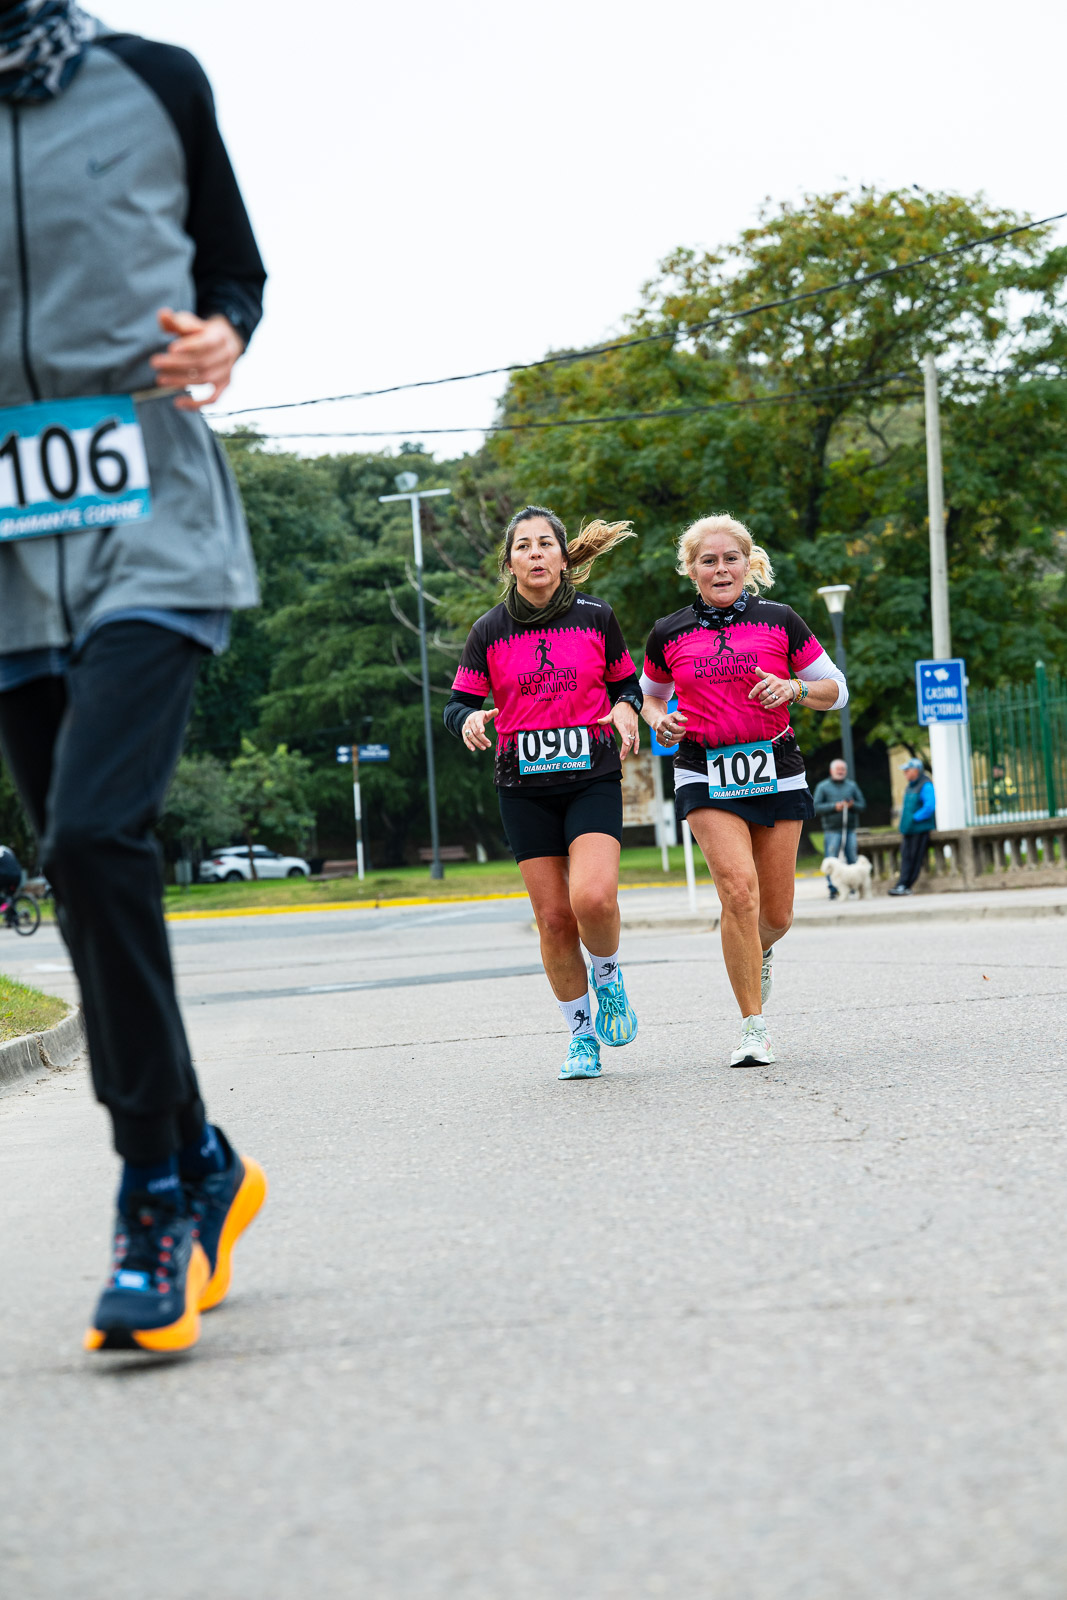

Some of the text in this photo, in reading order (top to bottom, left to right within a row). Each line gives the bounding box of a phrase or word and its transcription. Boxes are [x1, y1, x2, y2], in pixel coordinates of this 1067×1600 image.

[0, 421, 128, 508] 106
[694, 653, 758, 669] WOMAN
[518, 669, 577, 686] WOMAN
[695, 664, 757, 679] RUNNING
[520, 680, 577, 696] RUNNING
[925, 686, 958, 700] CASINO
[523, 727, 582, 762] 090
[523, 760, 587, 773] DIAMANTE CORRE
[712, 749, 771, 788] 102
[713, 785, 775, 798] DIAMANTE CORRE
